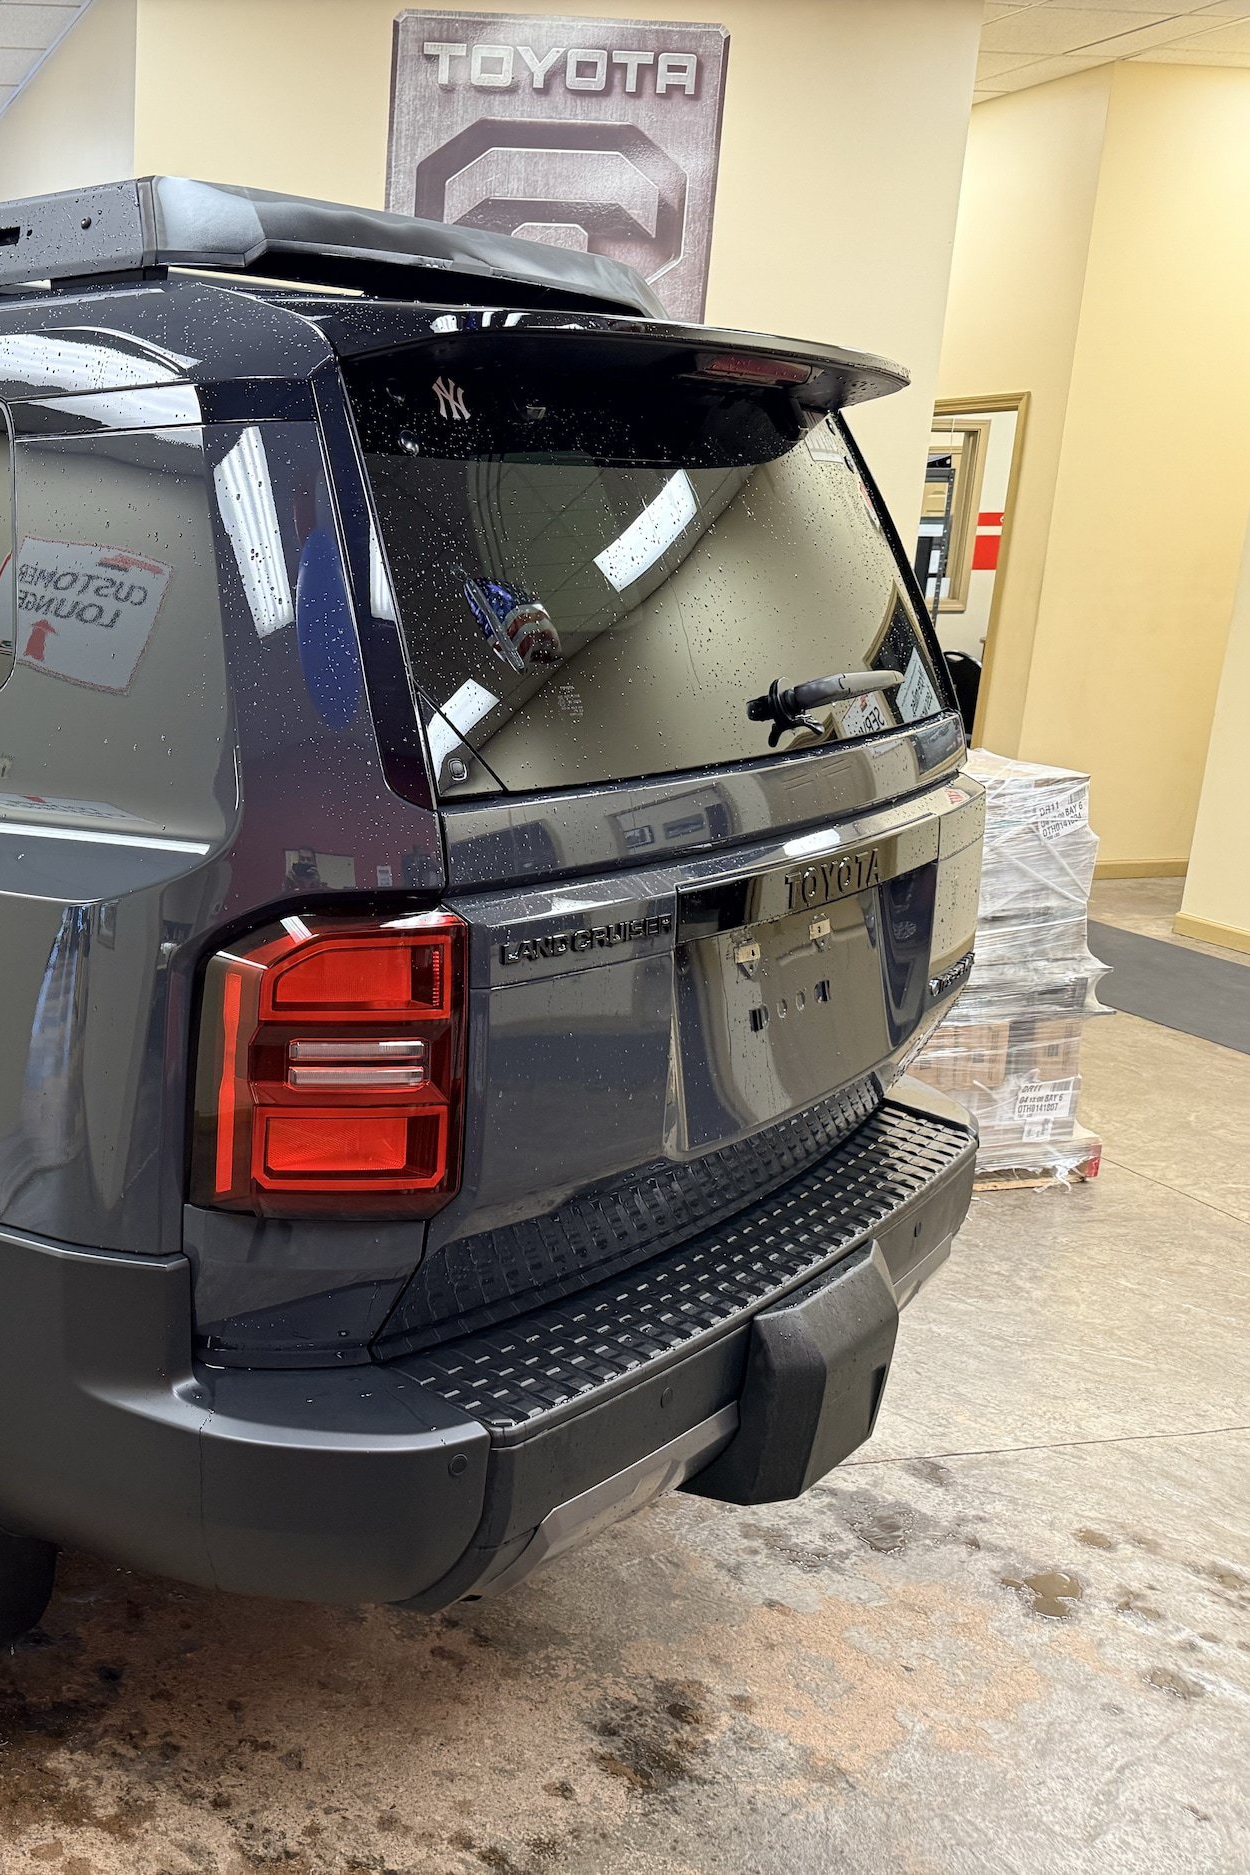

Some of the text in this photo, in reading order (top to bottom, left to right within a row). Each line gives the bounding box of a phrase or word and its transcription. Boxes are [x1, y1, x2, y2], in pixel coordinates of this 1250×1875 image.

[423, 42, 698, 95] TOYOTA
[785, 848, 880, 909] TOYOTA
[500, 913, 672, 965] LAND CRUISER
